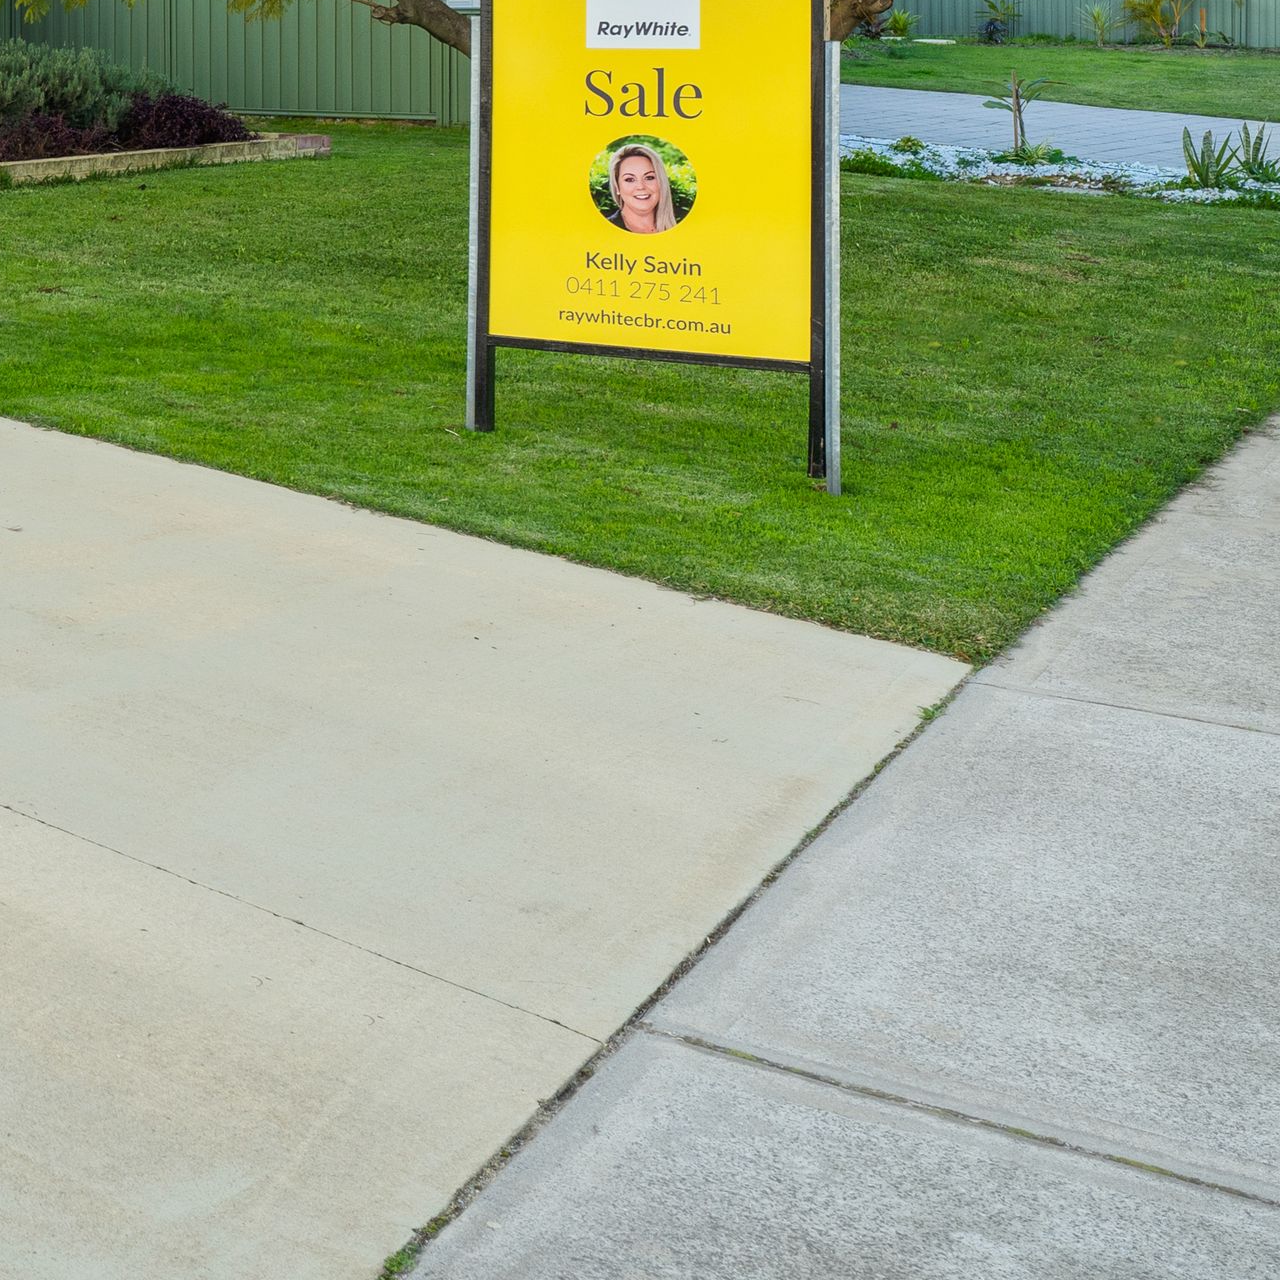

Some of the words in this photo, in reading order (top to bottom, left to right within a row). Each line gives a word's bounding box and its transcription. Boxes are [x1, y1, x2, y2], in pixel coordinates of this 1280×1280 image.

[585, 68, 702, 119] Sale
[586, 251, 637, 276] Kelly
[644, 255, 701, 276] Savin
[566, 276, 619, 297] 0411
[629, 281, 671, 301] 275
[679, 284, 721, 305] 241
[559, 309, 731, 335] raywhitecbr.com.au
